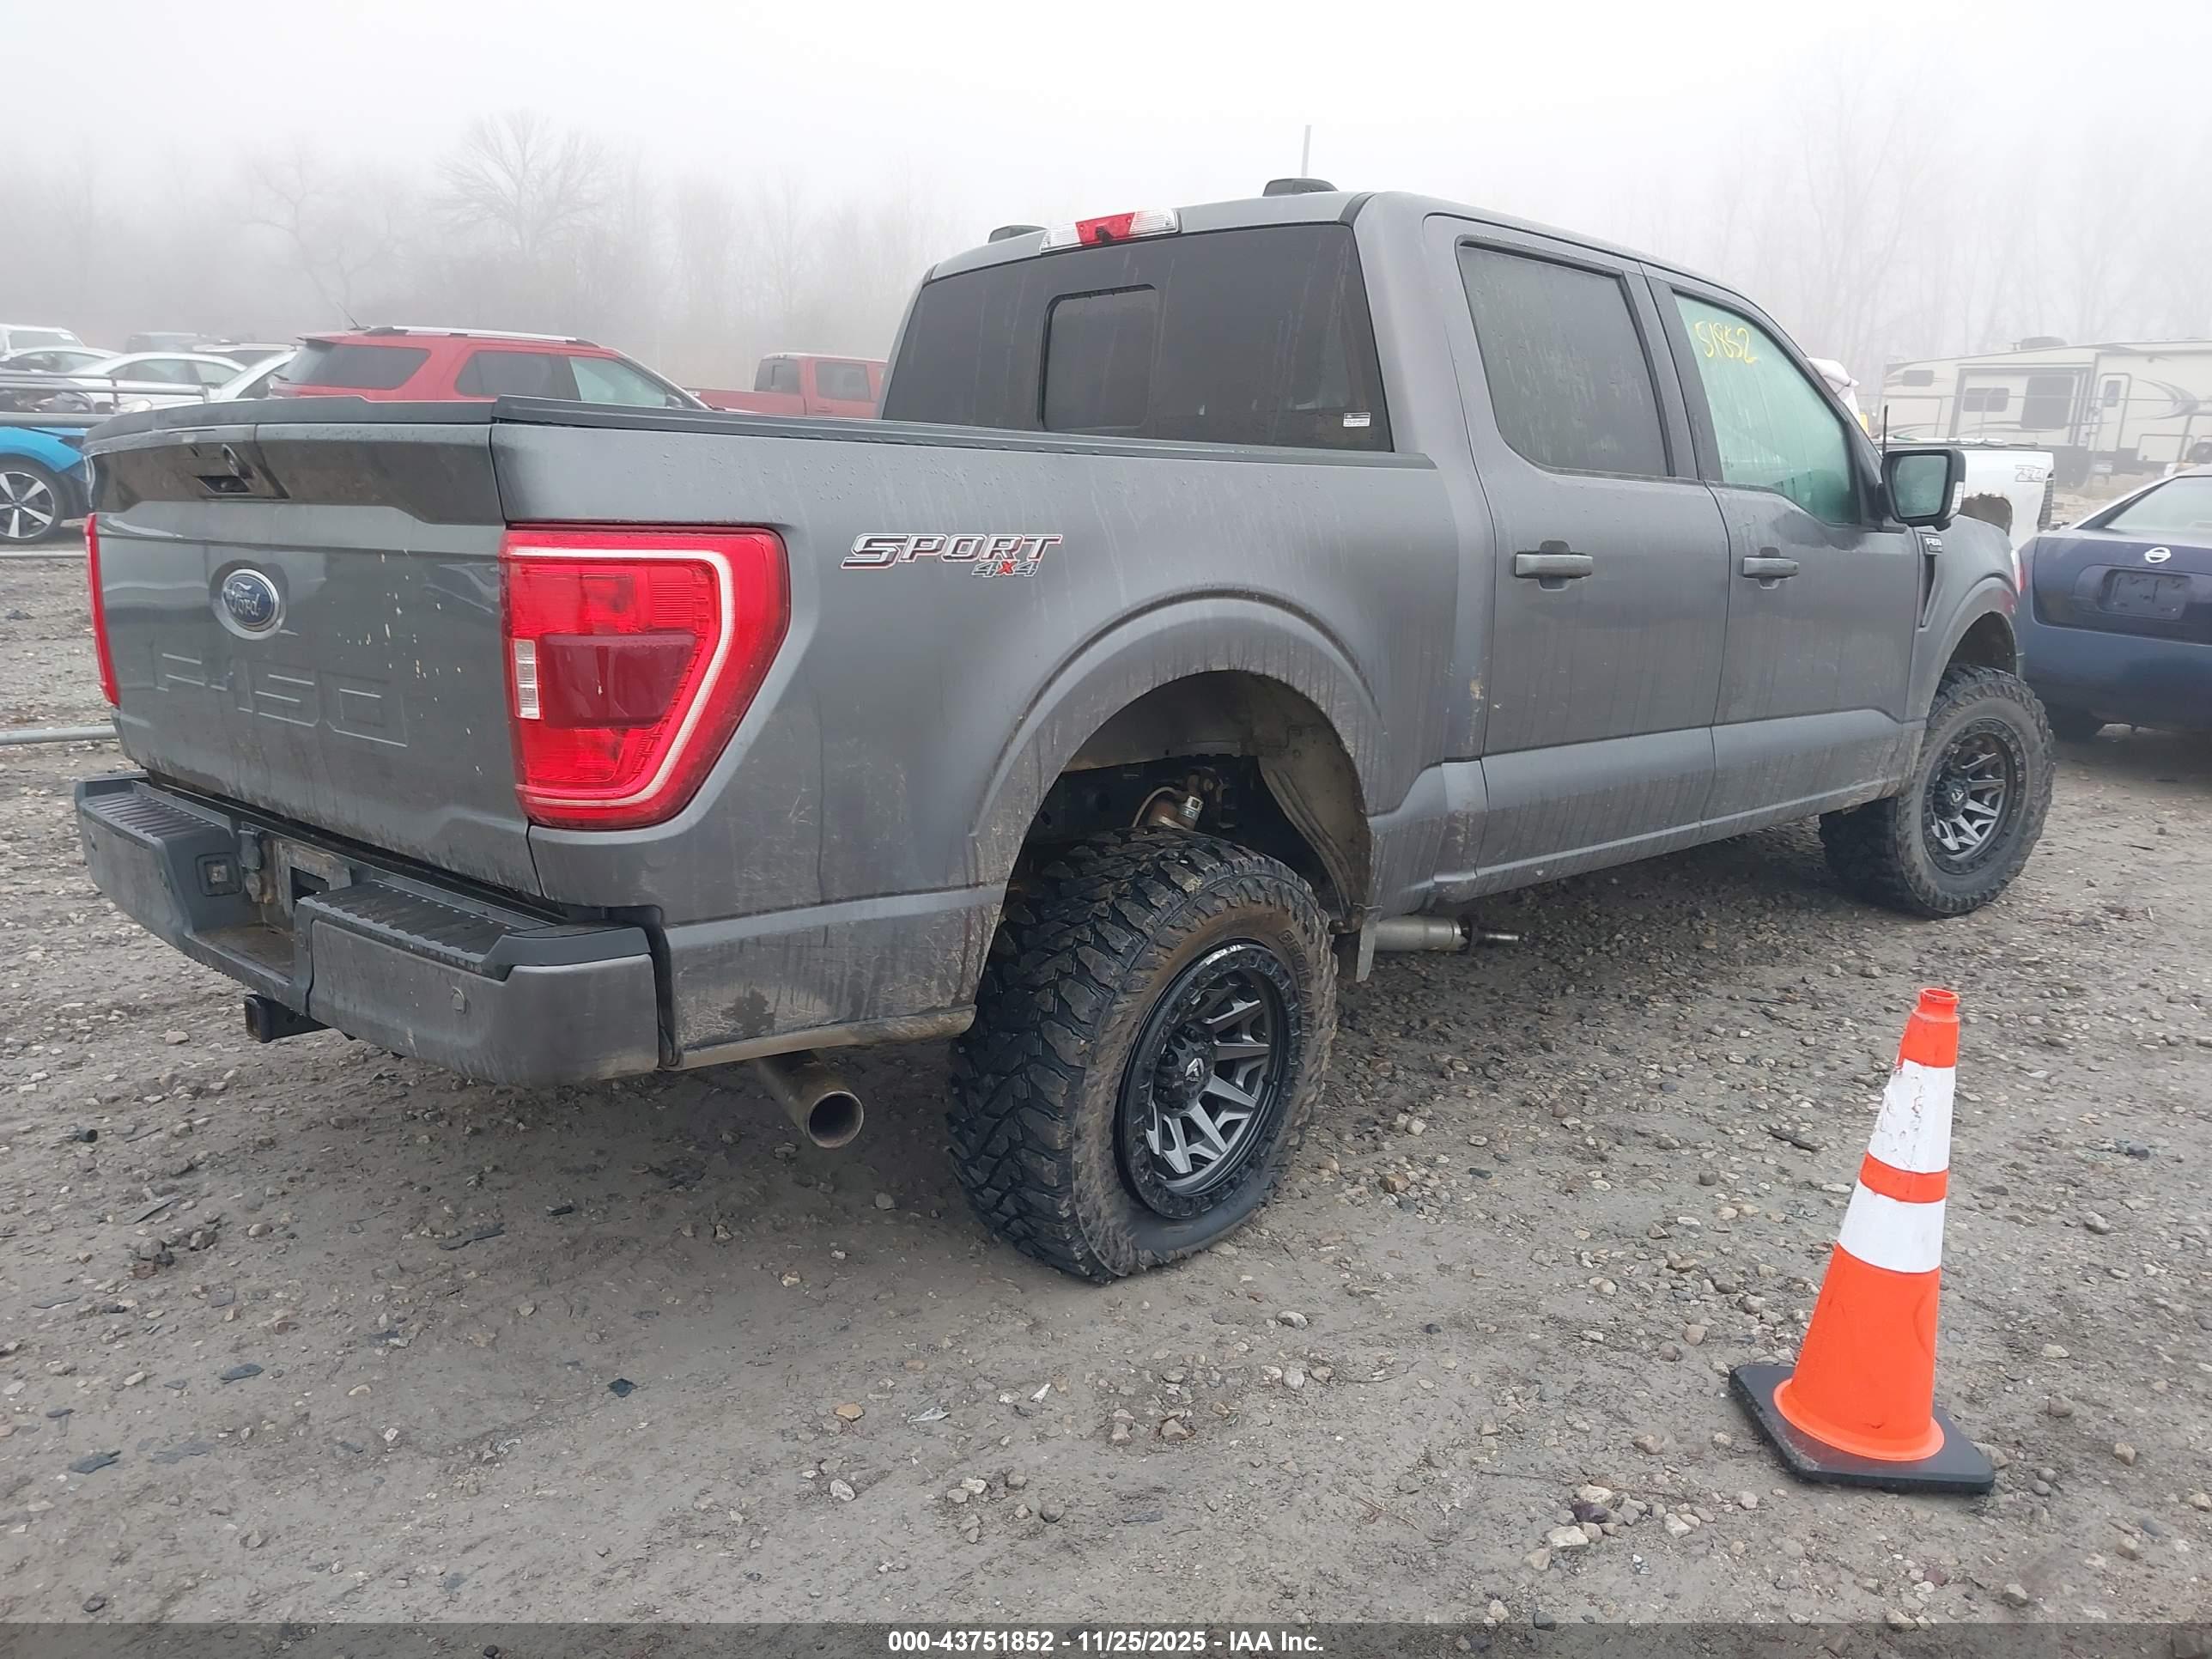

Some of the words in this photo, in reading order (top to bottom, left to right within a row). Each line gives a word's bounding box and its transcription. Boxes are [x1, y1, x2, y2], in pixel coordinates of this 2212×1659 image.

[1694, 320, 1758, 364] 51852
[841, 532, 1063, 569] SPORT
[226, 581, 261, 617] Ford
